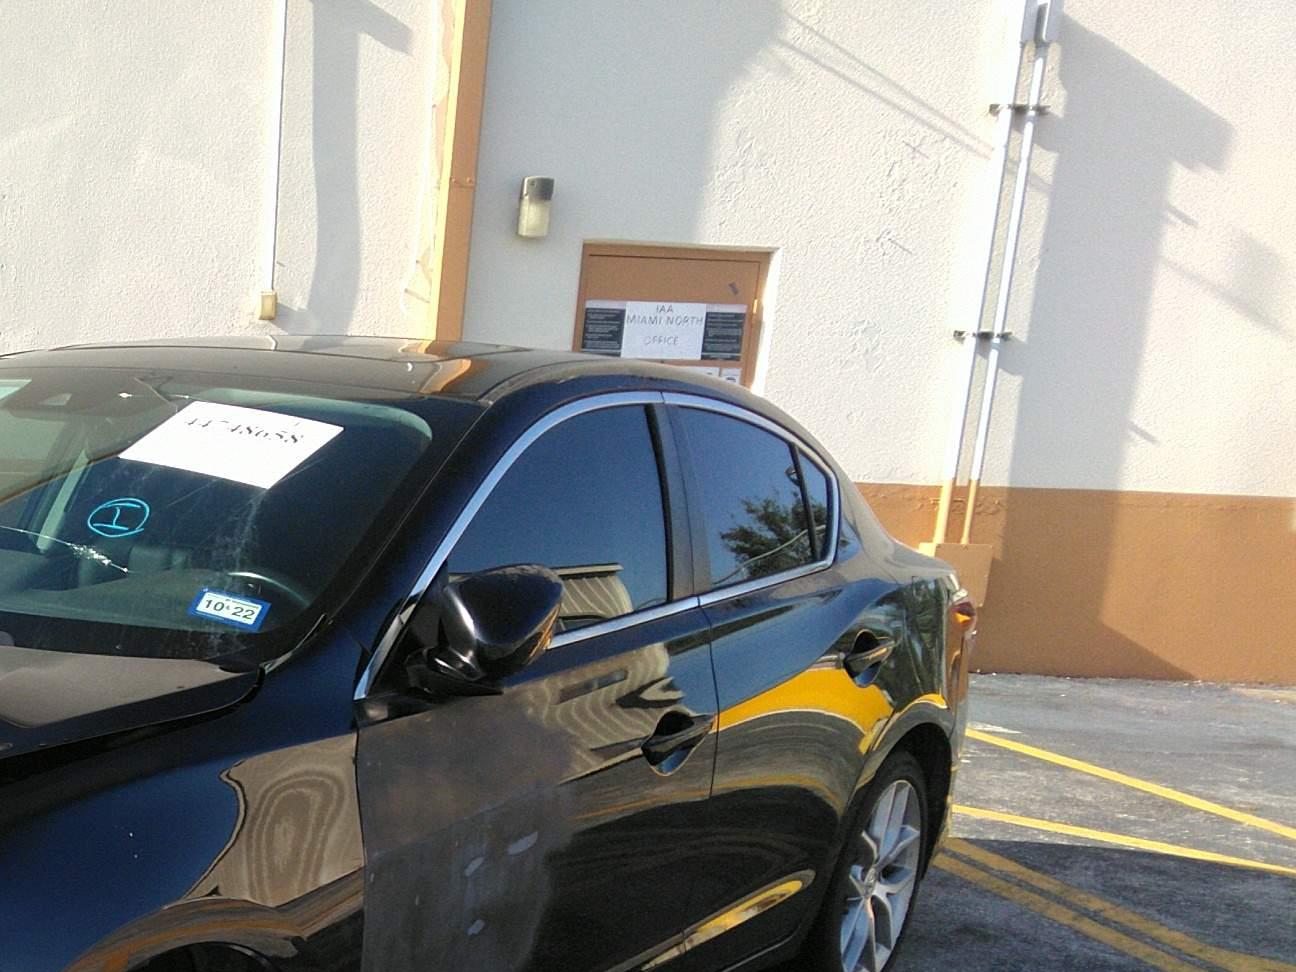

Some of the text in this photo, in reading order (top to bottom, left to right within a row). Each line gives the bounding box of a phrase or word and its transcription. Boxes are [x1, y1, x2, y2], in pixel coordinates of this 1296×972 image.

[655, 304, 674, 313] IAA
[625, 313, 704, 326] MIAMI NORTH
[644, 335, 679, 346] OFFICE
